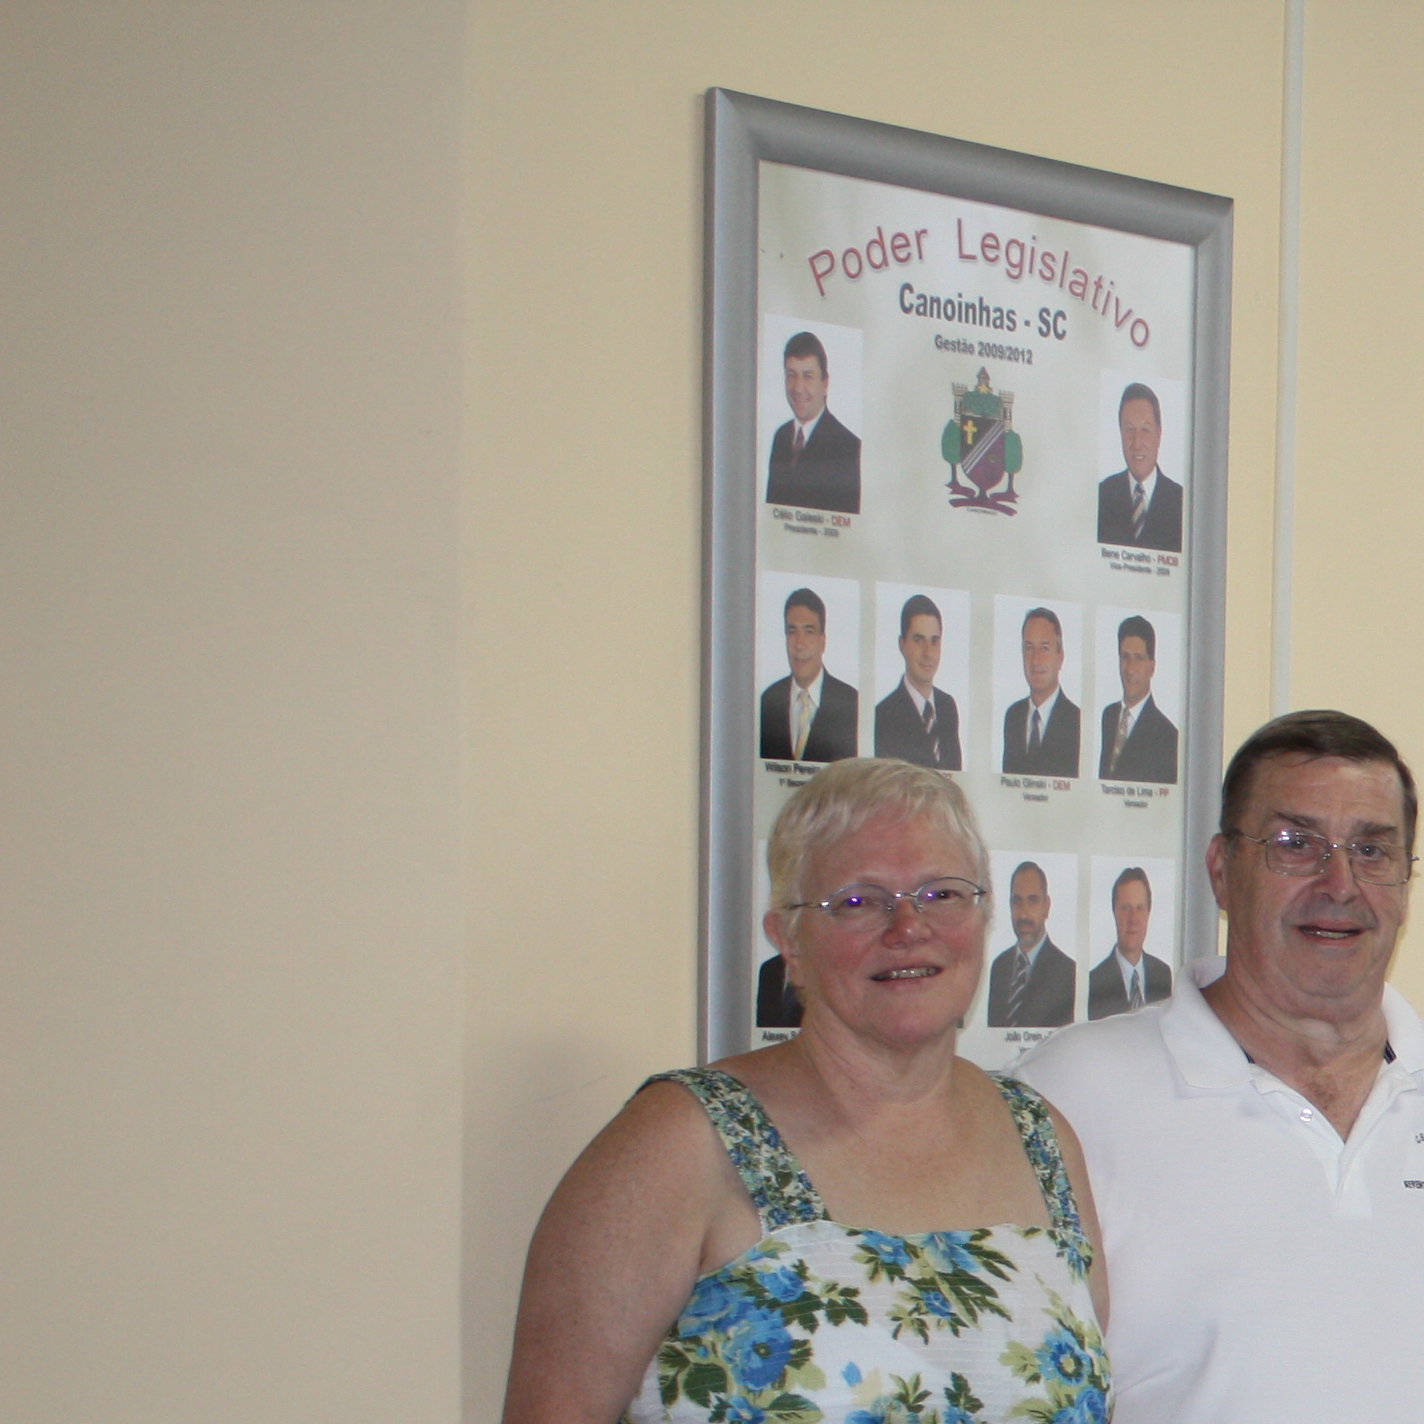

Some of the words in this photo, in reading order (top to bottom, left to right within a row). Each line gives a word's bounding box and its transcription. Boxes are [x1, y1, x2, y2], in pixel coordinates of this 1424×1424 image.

[808, 226, 928, 297] Poder
[957, 218, 1149, 347] Legislativo
[899, 282, 1017, 332] Canoinhas
[1038, 306, 1067, 340] SC
[935, 334, 974, 355] Gestão
[977, 341, 1033, 365] 2009/2012
